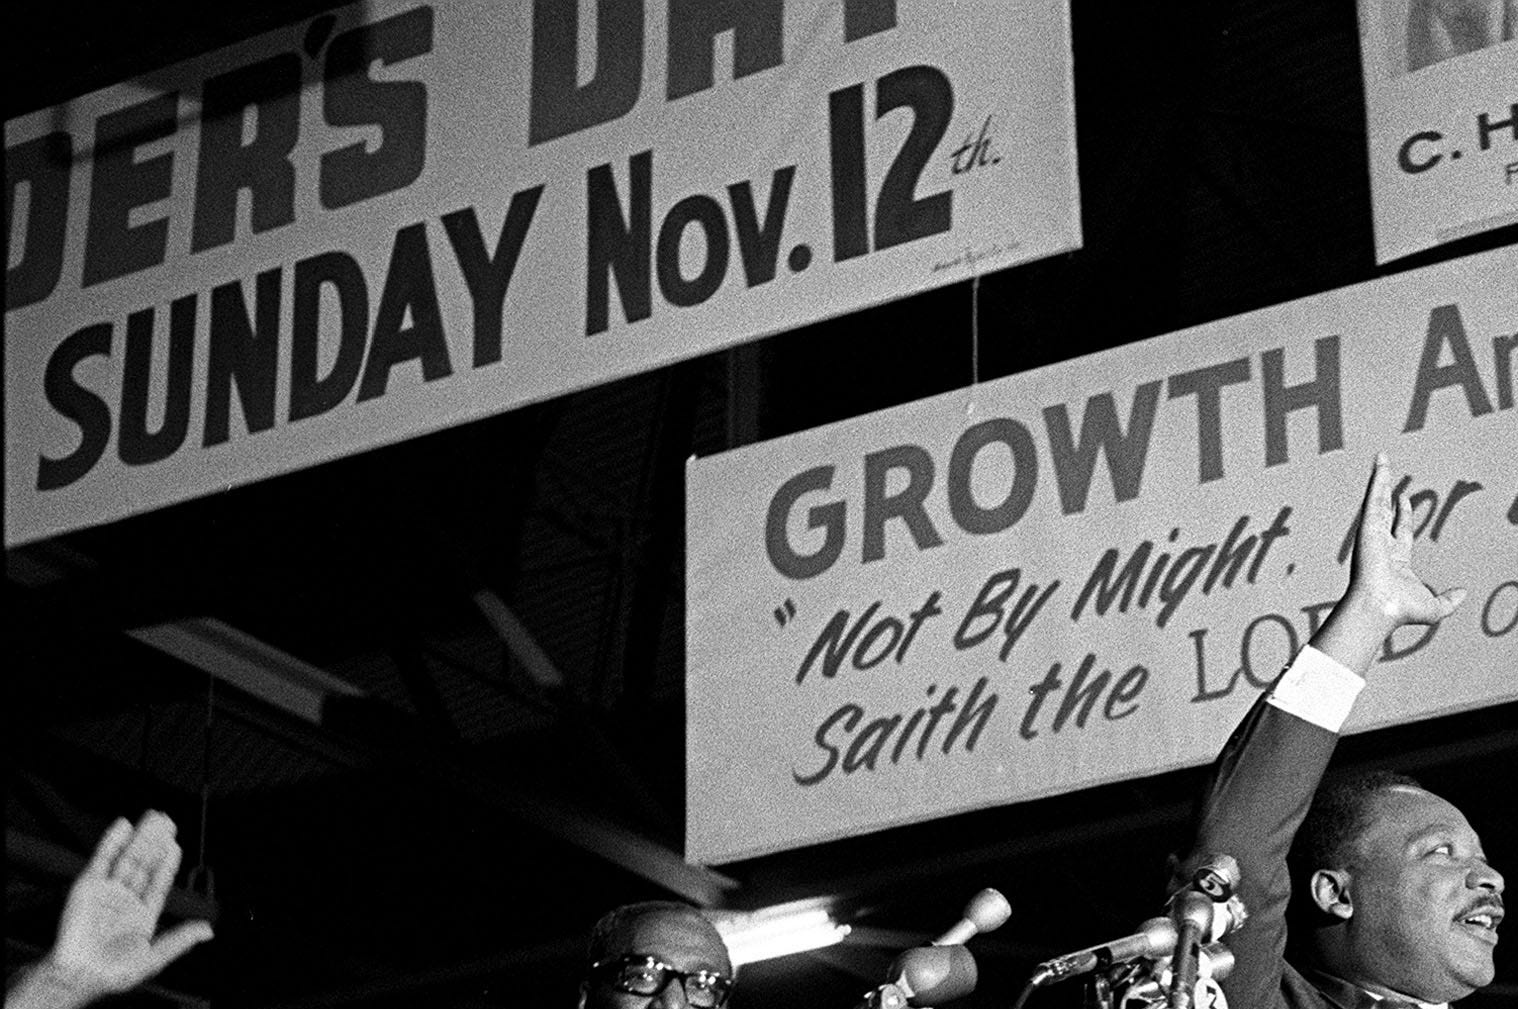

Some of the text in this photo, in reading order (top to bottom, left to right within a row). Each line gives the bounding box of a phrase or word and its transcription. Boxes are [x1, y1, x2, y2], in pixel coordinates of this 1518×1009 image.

[1398, 130, 1462, 174] C.
[36, 184, 546, 492] SUNDAY
[585, 150, 812, 337] Nov.
[765, 335, 1345, 581] GROWTH
[953, 568, 1060, 662] By
[1071, 506, 1295, 628] Might.
[793, 676, 998, 787] Saith
[1019, 653, 1150, 741] the
